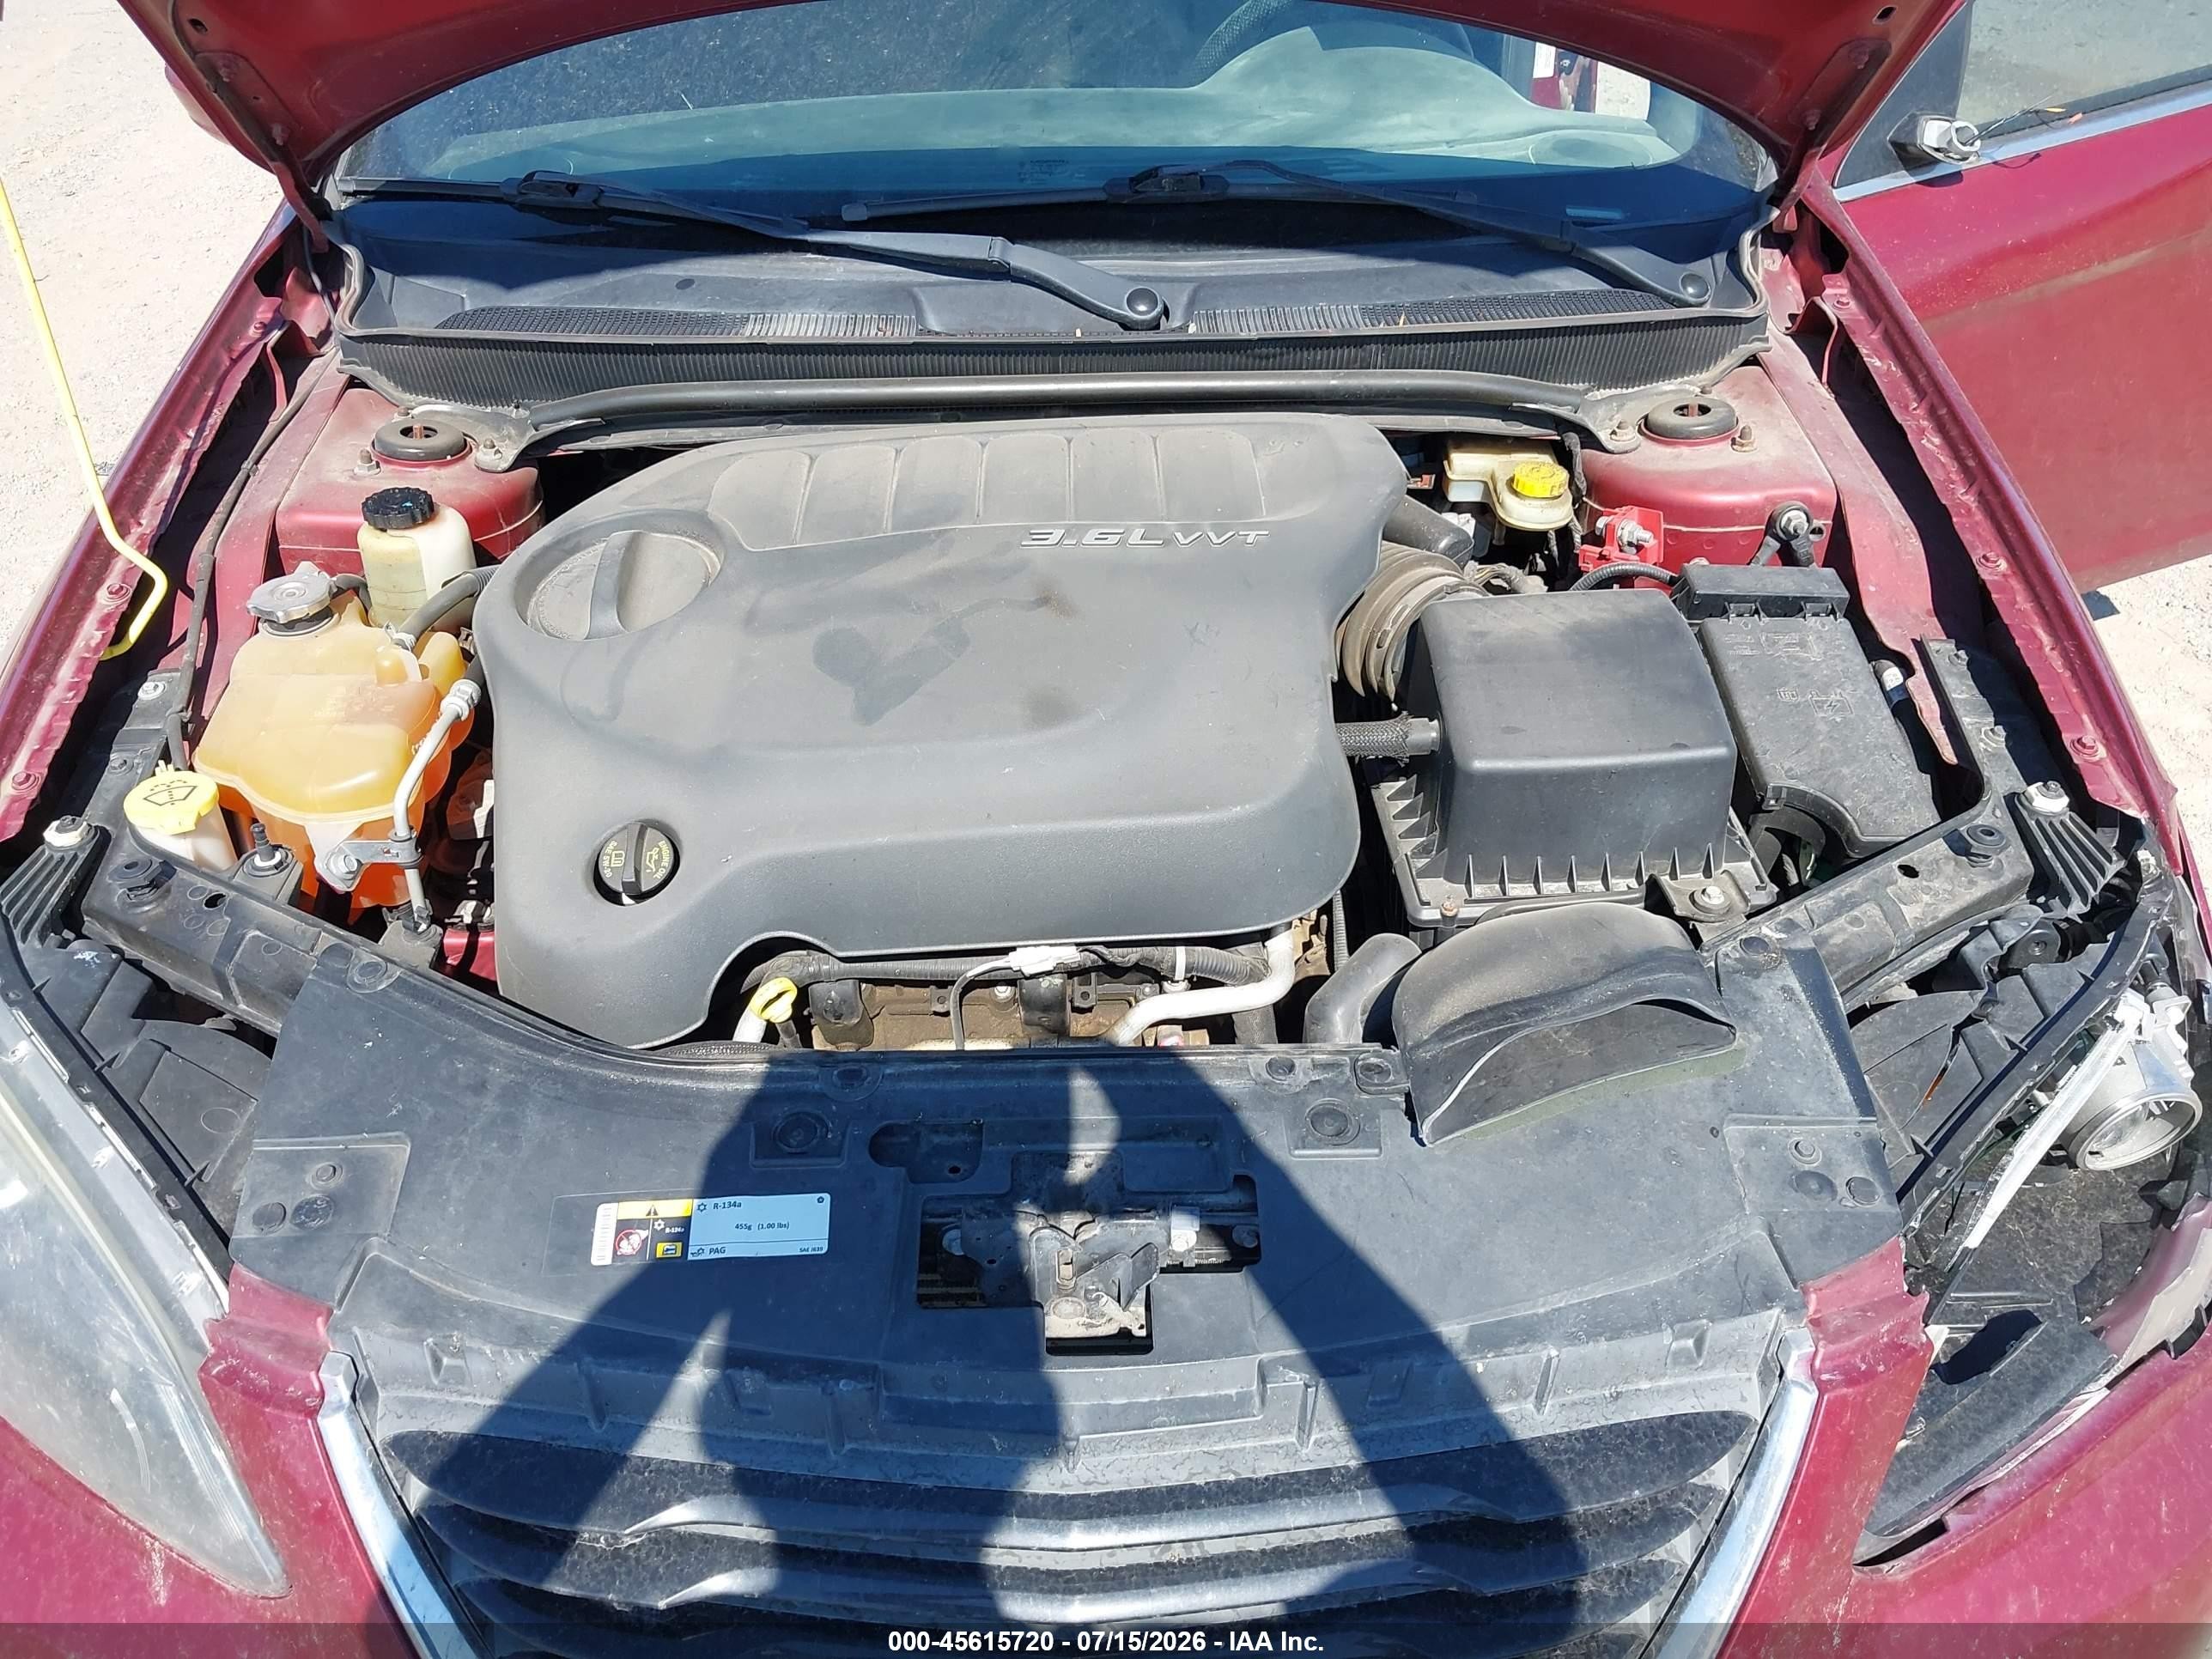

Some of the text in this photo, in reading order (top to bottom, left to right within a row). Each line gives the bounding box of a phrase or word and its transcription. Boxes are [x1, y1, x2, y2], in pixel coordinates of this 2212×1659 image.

[1020, 528, 1270, 548] 3.6L VVT
[603, 841, 618, 878] SAE 5W-20
[653, 841, 670, 879] ENGINE OIL
[713, 1200, 742, 1210] R-134a
[734, 1221, 790, 1231] 455g (1.00 lbs)
[708, 1246, 726, 1255] PAG
